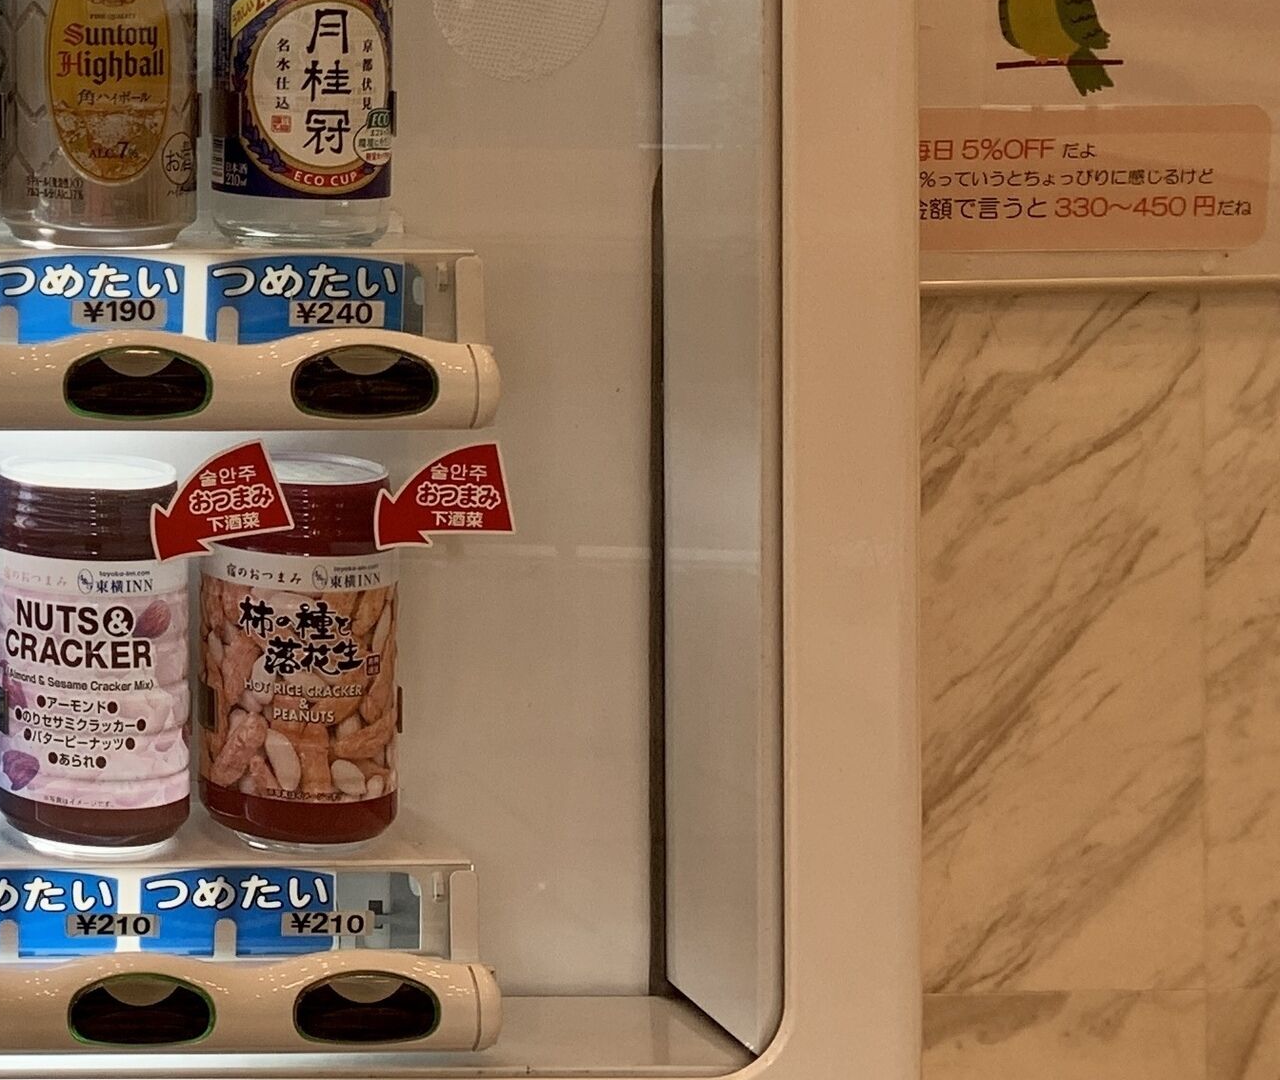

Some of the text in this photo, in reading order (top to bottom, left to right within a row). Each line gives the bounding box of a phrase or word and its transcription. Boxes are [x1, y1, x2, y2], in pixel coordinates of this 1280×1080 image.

[63, 22, 158, 51] Suntory
[56, 50, 164, 85] Highball
[274, 37, 291, 111] 名水仕込
[361, 38, 374, 112] 京都伏見
[301, 8, 352, 154] 月桂冠
[78, 88, 152, 106] 角ハイボール
[961, 138, 1057, 161] 5%OFF
[1062, 141, 1097, 160] だよ
[1054, 196, 1188, 220] 330〜450
[1193, 196, 1253, 220] 円だね
[83, 299, 157, 323] ¥190
[297, 301, 374, 325] ¥240
[429, 462, 489, 482] 술안주
[206, 511, 261, 532] 下酒菜
[430, 510, 485, 529] 下酒菜
[96, 577, 154, 594] 東横INN
[329, 574, 382, 590] 東横INN
[236, 595, 354, 641] 柿の種と
[5, 627, 153, 670] CRACKER
[262, 635, 365, 676] 落花生
[243, 677, 364, 698] HOT RICE CRACKER
[272, 705, 336, 724] PEANUTS
[77, 912, 152, 936] ¥210
[290, 911, 366, 935] ¥210
